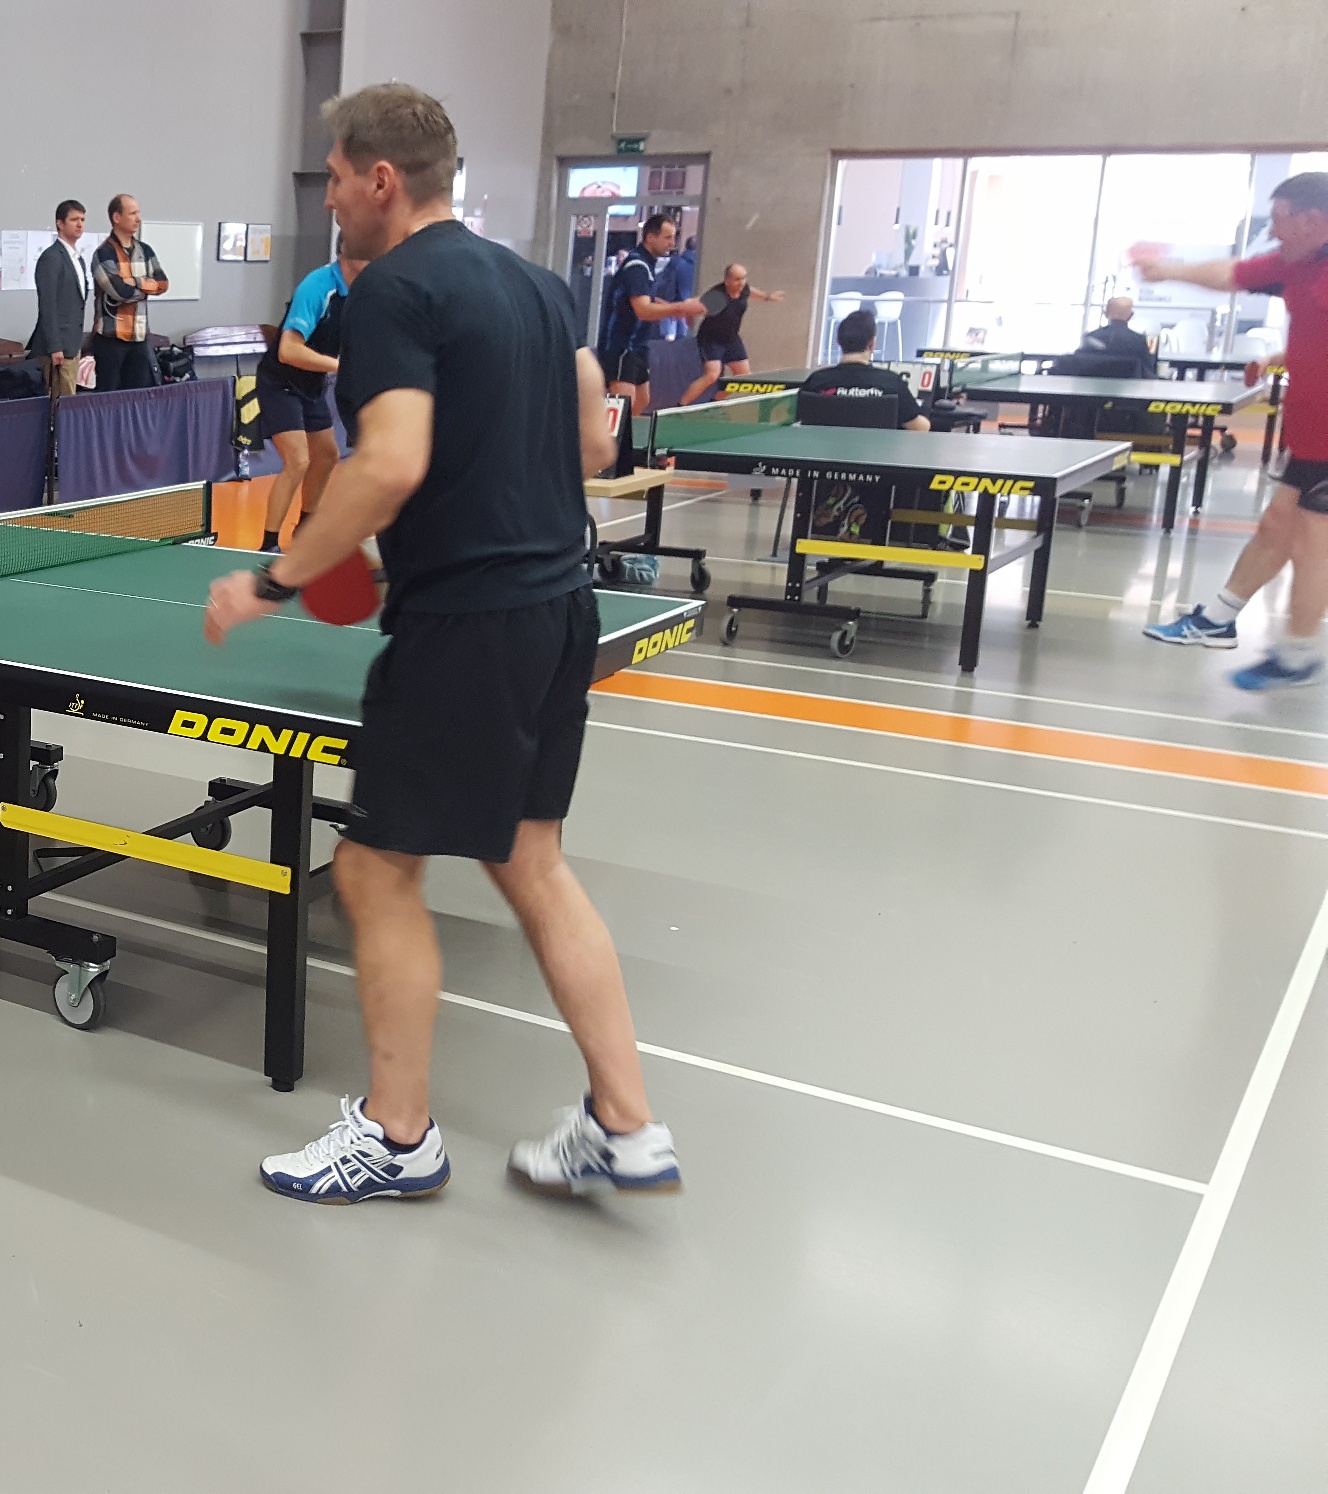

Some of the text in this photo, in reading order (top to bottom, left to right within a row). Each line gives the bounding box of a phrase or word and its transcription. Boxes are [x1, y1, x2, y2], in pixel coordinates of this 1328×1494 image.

[725, 382, 786, 393] DONIC
[1147, 401, 1222, 416] DONIC
[772, 467, 880, 483] MADE IN GERMANY
[929, 474, 1035, 496] DONIC
[632, 619, 695, 665] DONIC
[92, 712, 109, 720] MADE
[120, 717, 149, 726] GERMANY
[167, 709, 349, 765] DONIC
[292, 1182, 303, 1190] GEL
